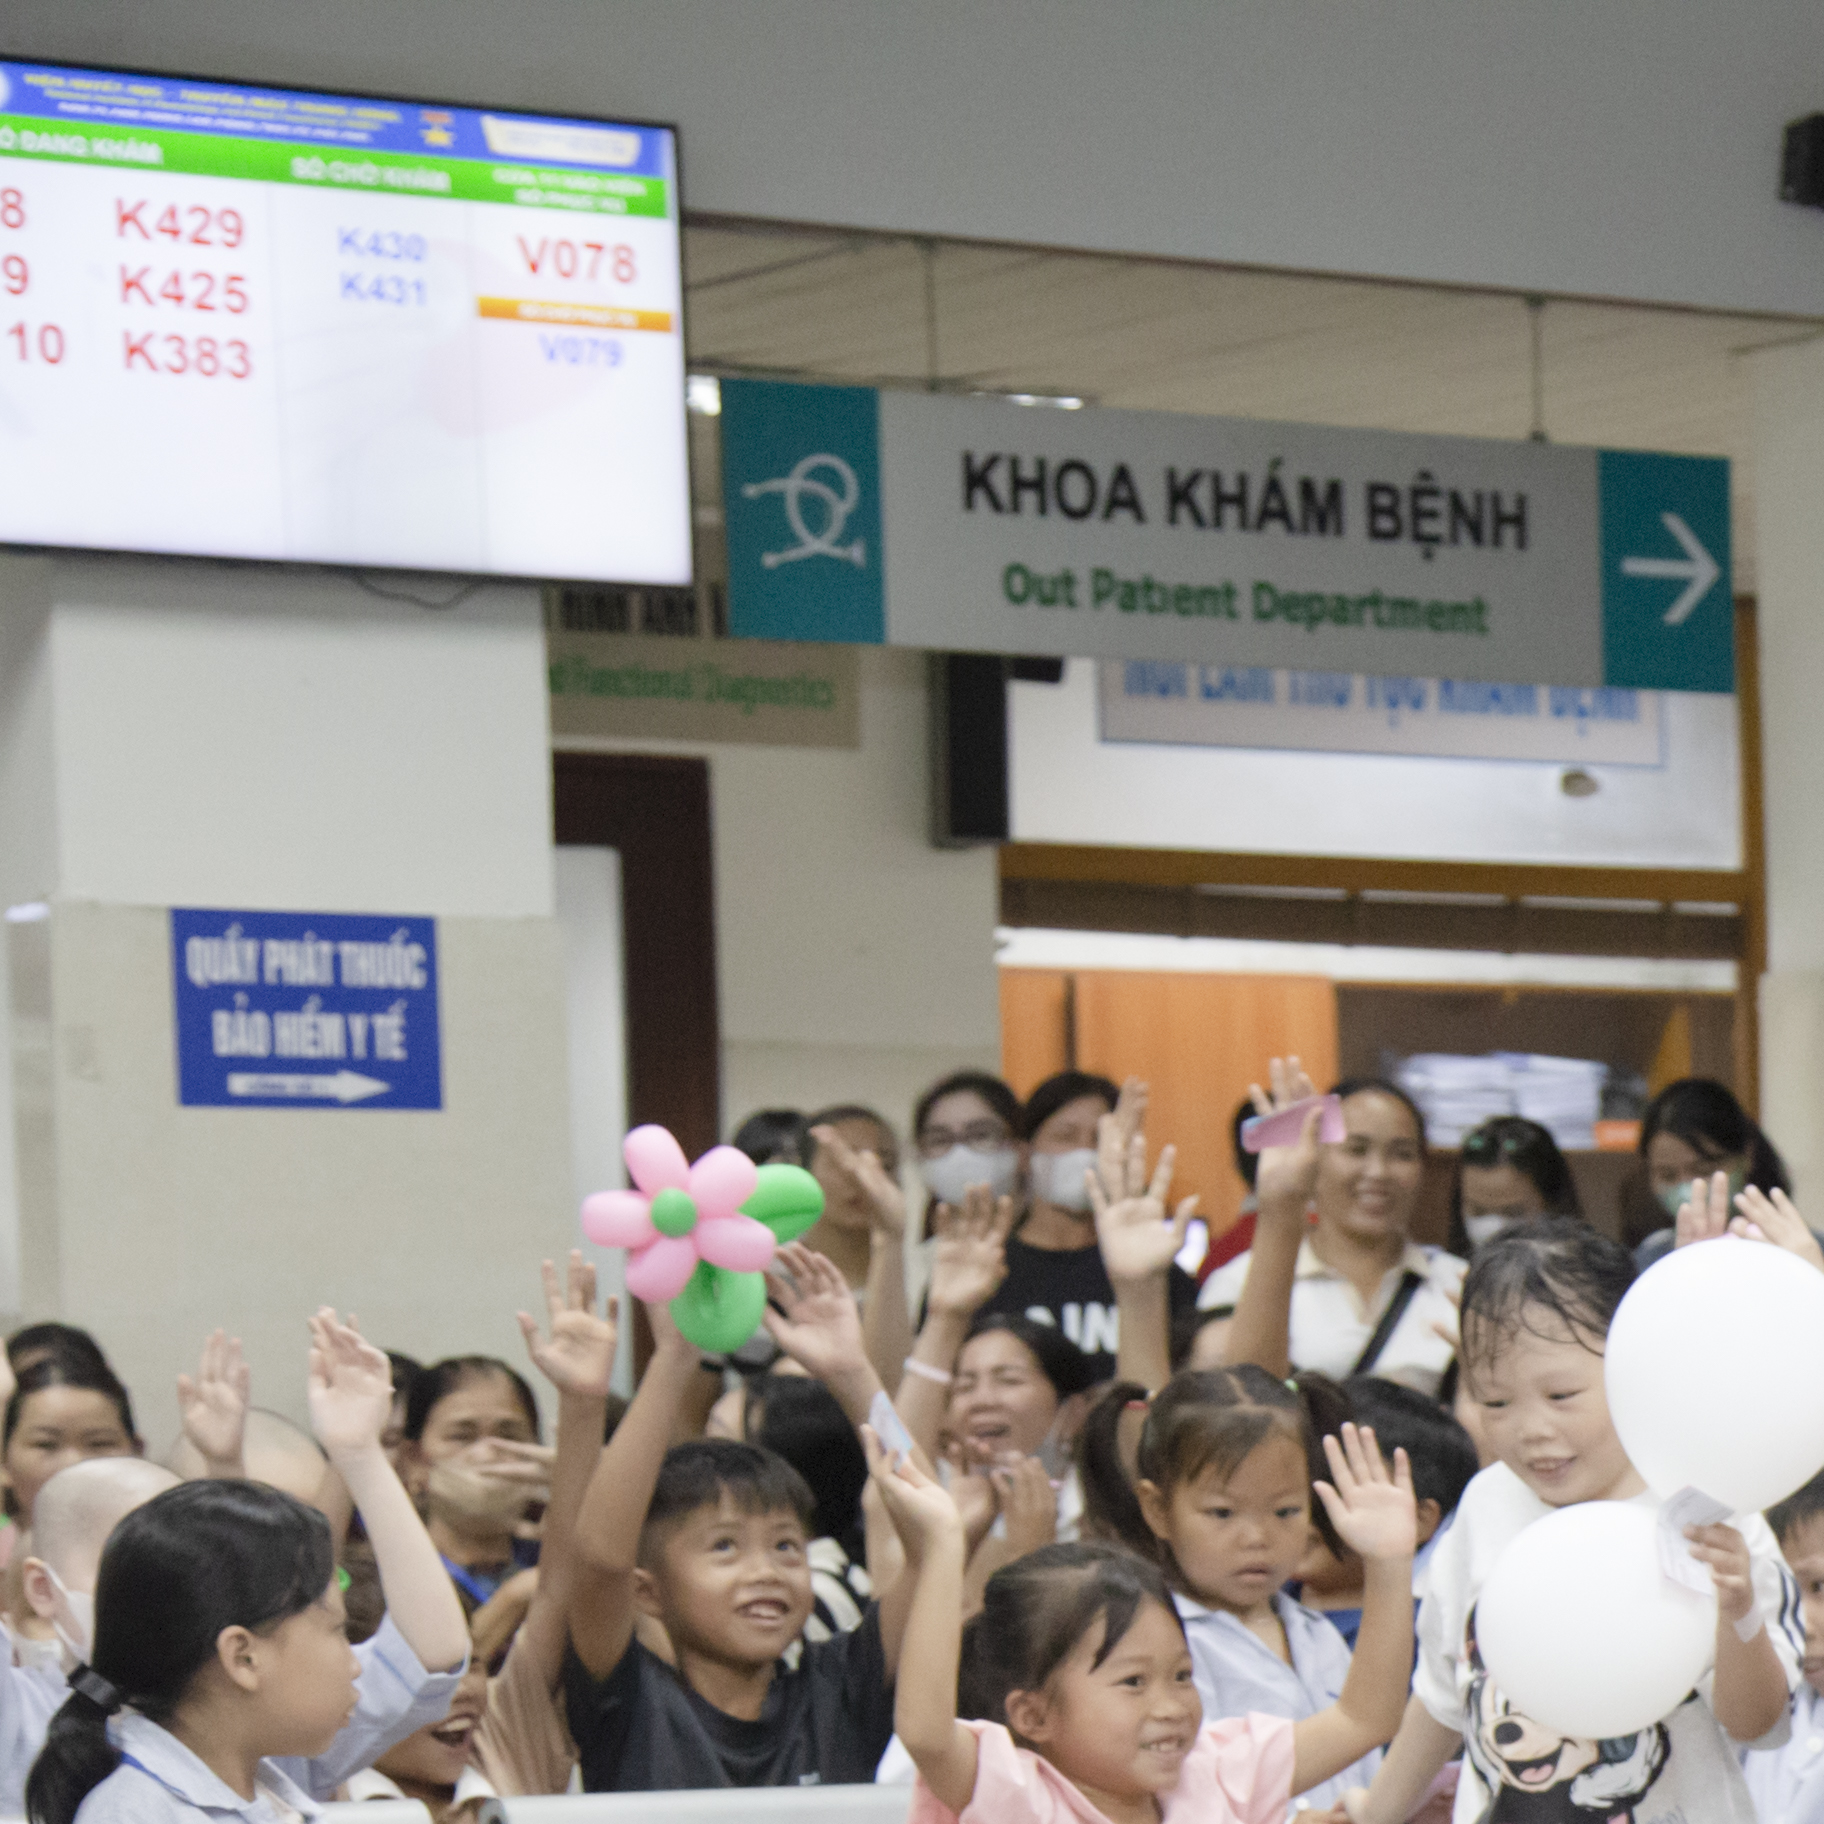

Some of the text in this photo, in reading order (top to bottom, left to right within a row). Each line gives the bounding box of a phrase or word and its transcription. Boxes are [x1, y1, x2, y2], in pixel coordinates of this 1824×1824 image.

[115, 197, 245, 248] K429
[338, 225, 637, 283] K430 V078
[2, 253, 250, 314] 9 K425
[339, 271, 427, 305] K431
[9, 322, 253, 380] 10 K383
[538, 333, 626, 367] V079
[961, 449, 1530, 561] KHOA KHÁM BỆNH
[1003, 562, 1491, 636] Out Patient Department
